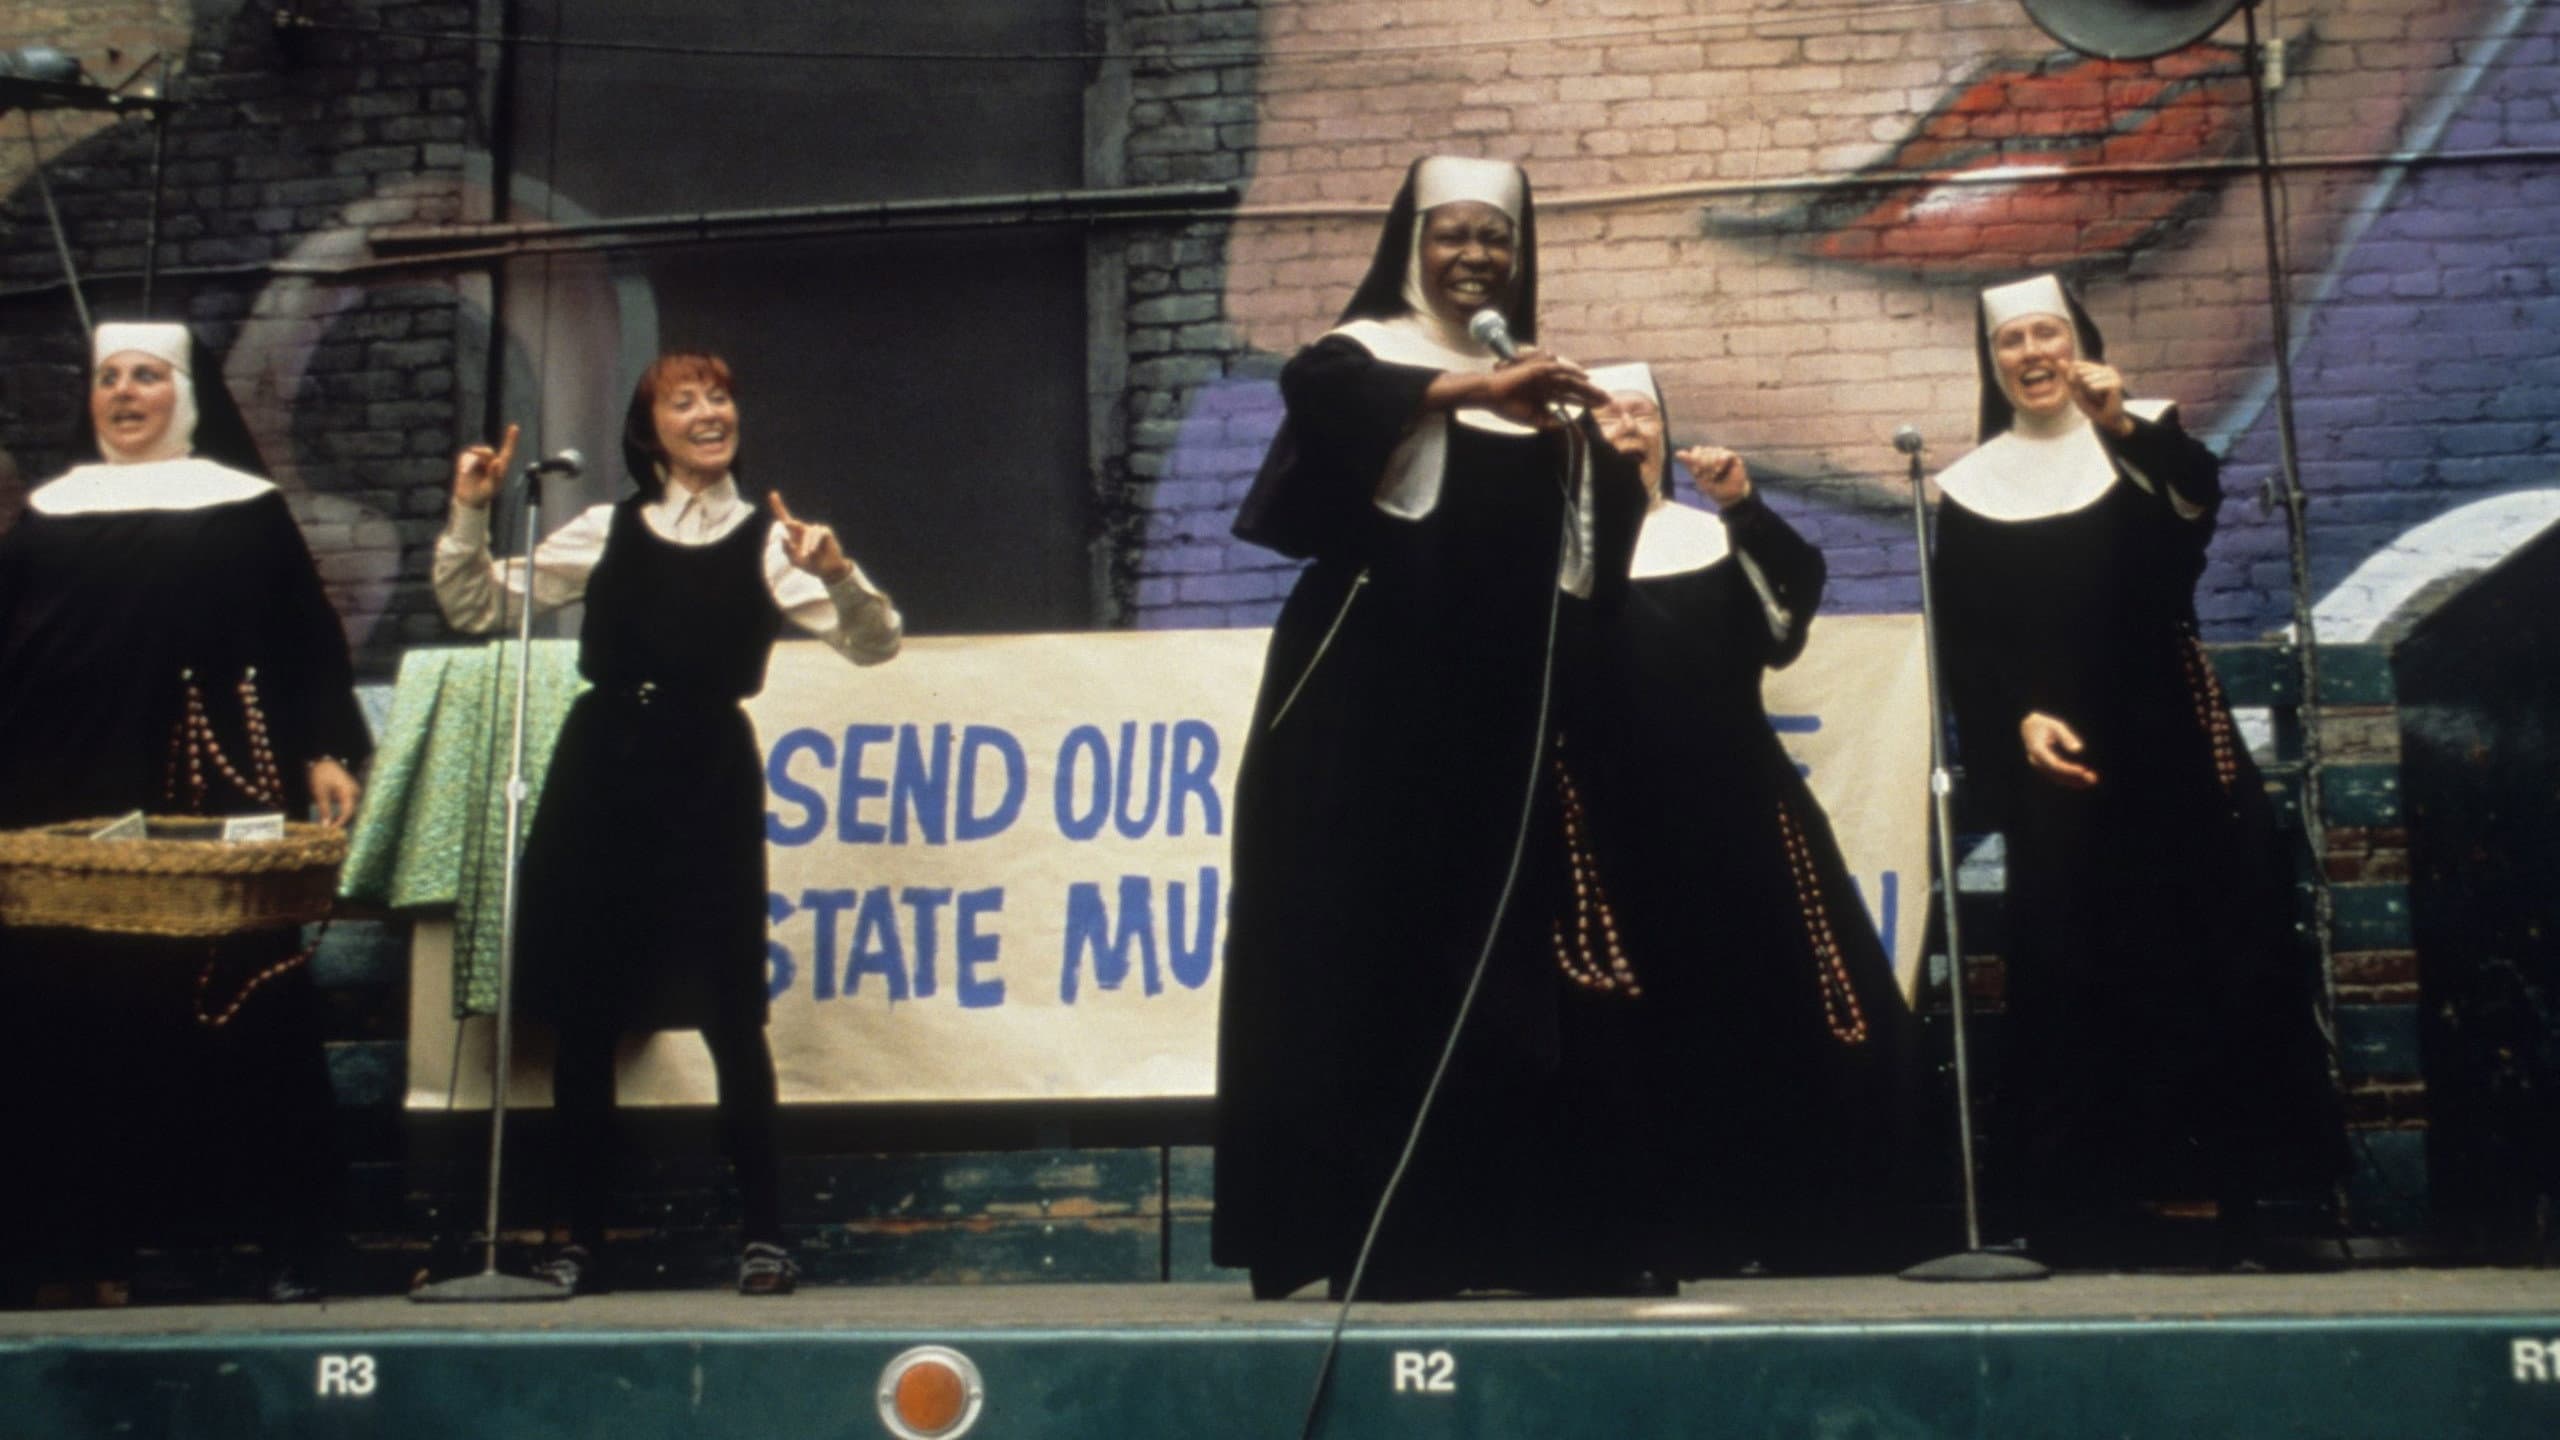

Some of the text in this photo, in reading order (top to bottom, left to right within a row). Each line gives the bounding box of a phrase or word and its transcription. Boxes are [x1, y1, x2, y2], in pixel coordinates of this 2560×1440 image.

[765, 719, 1223, 846] SEND OUR
[317, 1354, 377, 1396] R3
[1394, 1350, 1456, 1392] R2
